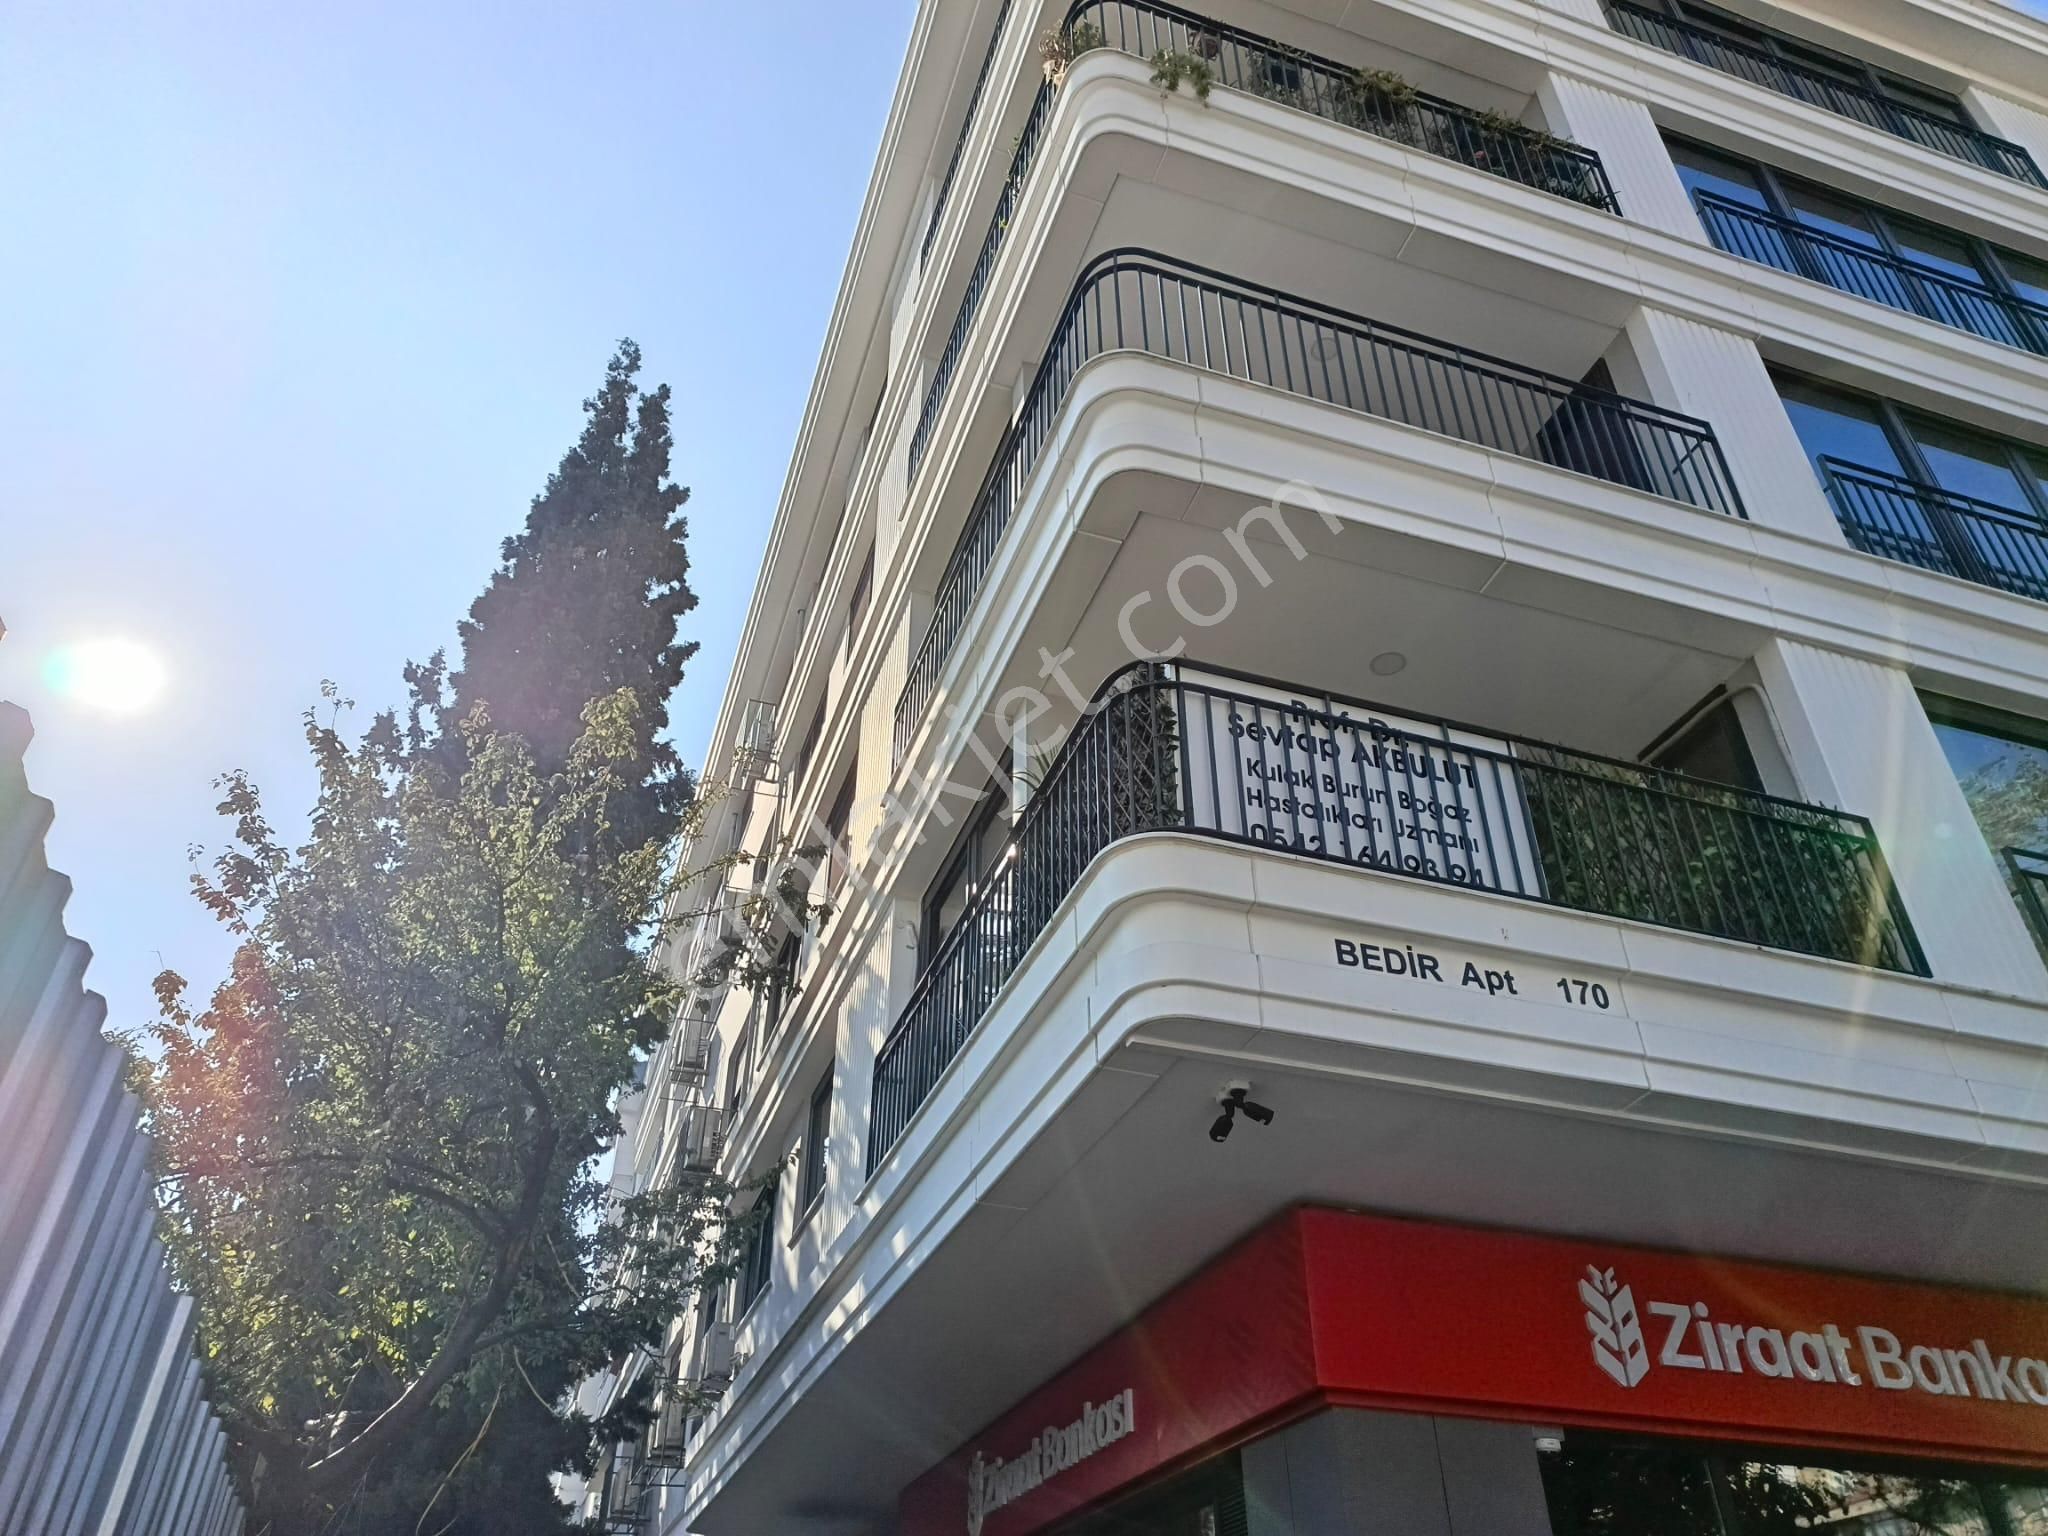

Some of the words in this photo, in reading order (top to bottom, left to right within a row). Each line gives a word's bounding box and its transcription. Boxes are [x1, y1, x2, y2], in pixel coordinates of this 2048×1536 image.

[1228, 713, 1341, 762] Sevtap
[1351, 741, 1474, 789] AKBULUT
[1246, 757, 1314, 789] Kulak
[1322, 773, 1389, 806] Burun
[1334, 938, 1443, 982] BEDİR
[1461, 962, 1518, 996] Apt
[1556, 977, 1610, 1010] 170
[1647, 1300, 1862, 1387] Ziraat
[982, 1437, 1043, 1518] Ziraat
